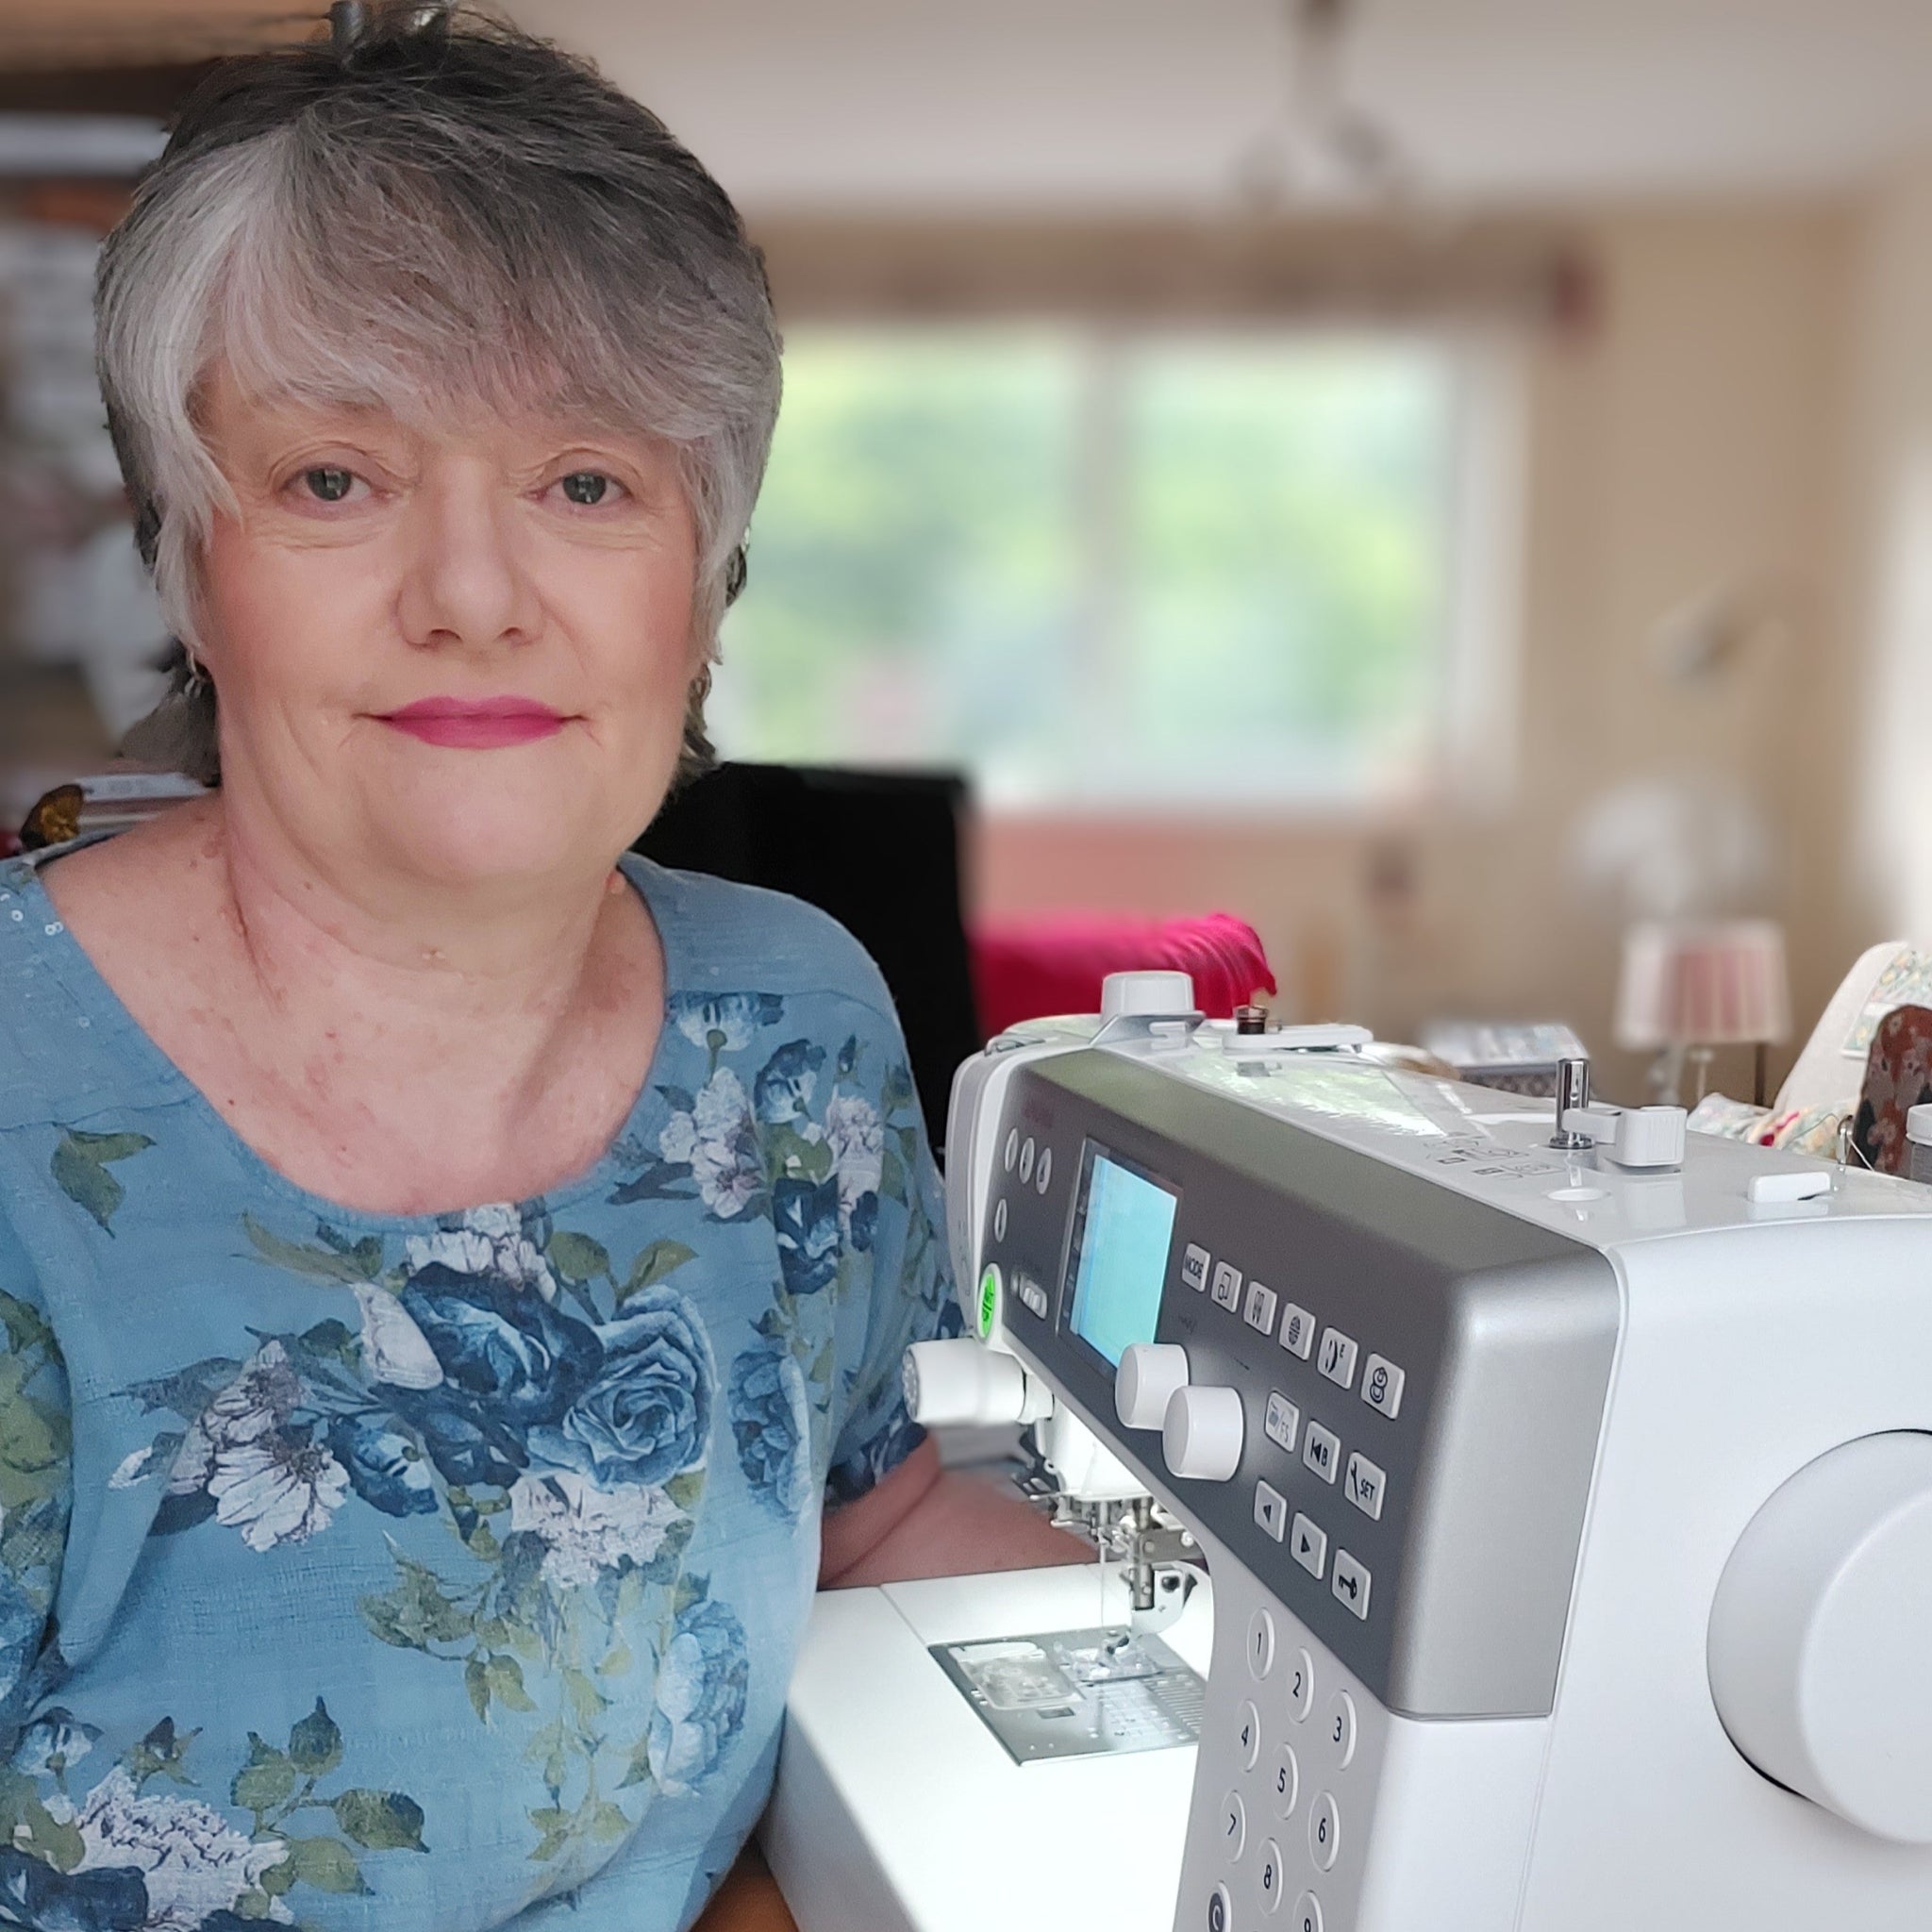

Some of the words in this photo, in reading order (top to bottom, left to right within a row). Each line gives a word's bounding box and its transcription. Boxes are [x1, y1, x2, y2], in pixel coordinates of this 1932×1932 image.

[1360, 1478, 1375, 1501] SET
[1292, 1672, 1301, 1697] 2
[1241, 1725, 1249, 1746] 4
[1332, 1716, 1342, 1742] 3
[1277, 1768, 1286, 1793] 5
[1227, 1813, 1236, 1836] 7
[1318, 1818, 1326, 1842] 6
[1264, 1864, 1272, 1890] 8
